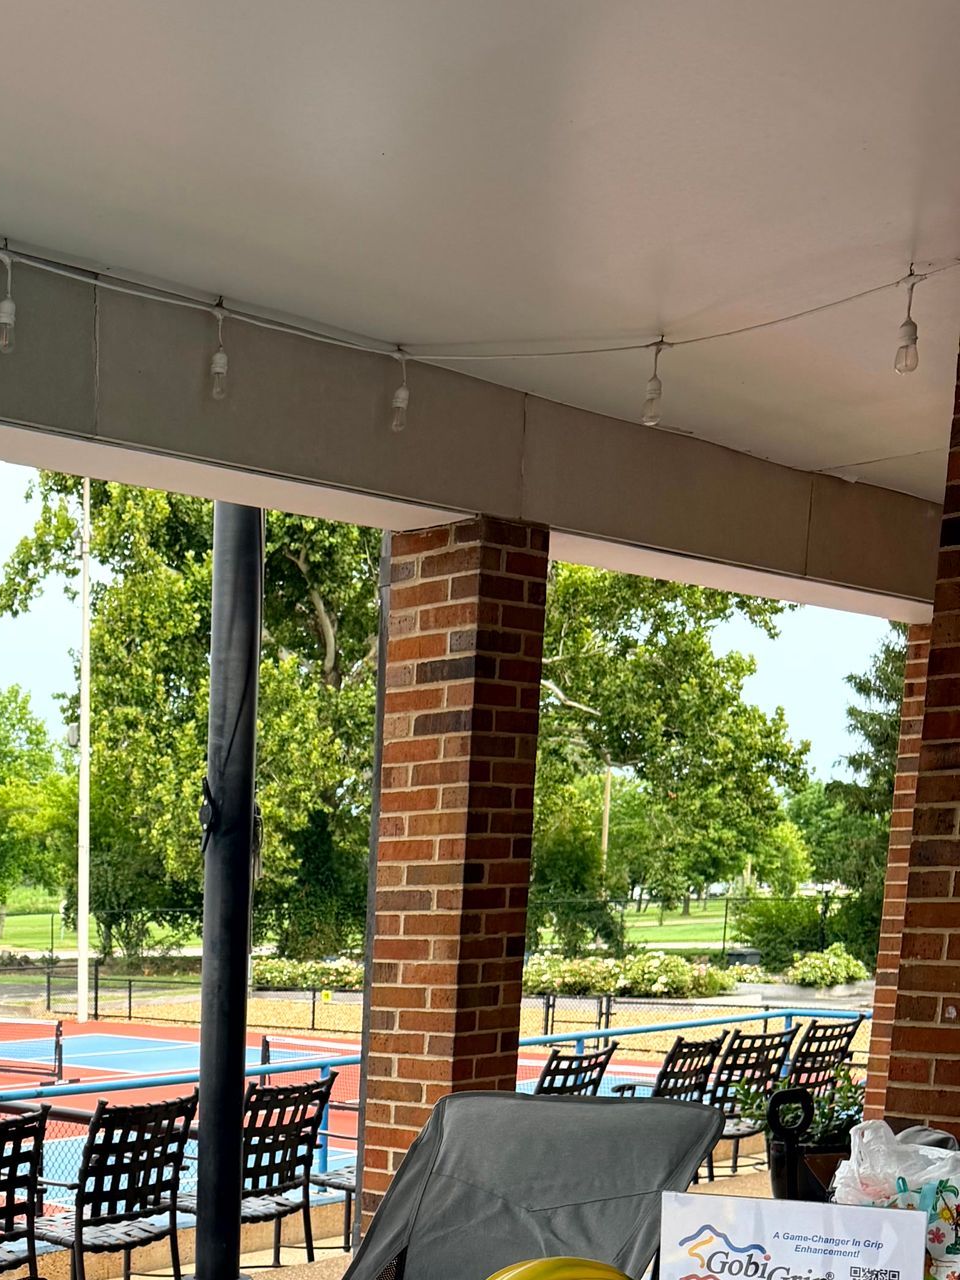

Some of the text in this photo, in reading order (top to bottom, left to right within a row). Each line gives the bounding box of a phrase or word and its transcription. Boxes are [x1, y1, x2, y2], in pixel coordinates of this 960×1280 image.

[773, 1232, 884, 1250] A Game-Changer In Grip
[795, 1244, 861, 1258] Enhancement!
